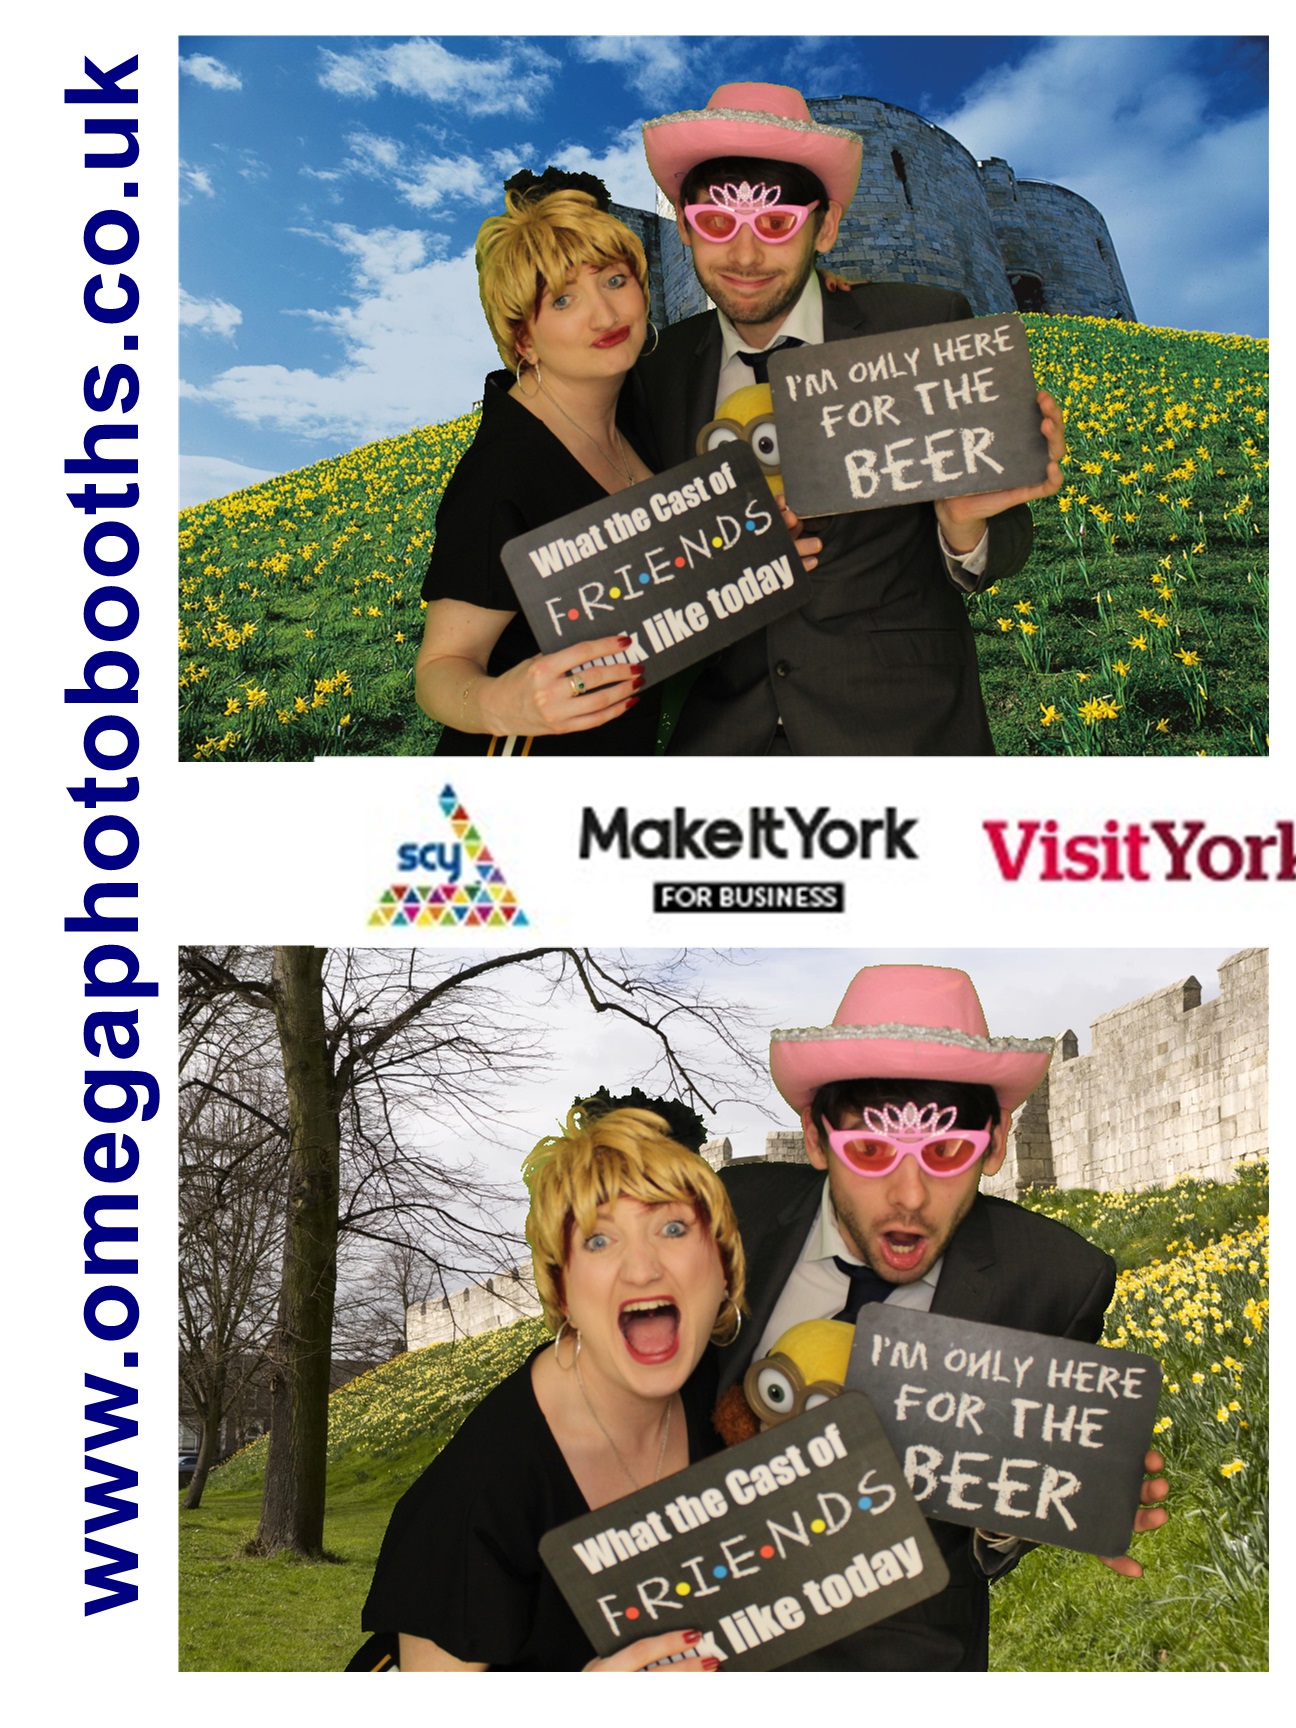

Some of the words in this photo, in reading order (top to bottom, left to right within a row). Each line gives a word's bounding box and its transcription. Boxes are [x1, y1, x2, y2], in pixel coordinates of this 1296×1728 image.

[785, 370, 837, 401] I'M
[848, 348, 920, 385] ONLY
[933, 325, 1015, 366] HERE
[820, 395, 900, 438] FOR
[914, 367, 1000, 416] THE
[844, 427, 1004, 499] BEER
[528, 527, 606, 578] What
[598, 504, 652, 544] the
[649, 477, 711, 523] Cast
[708, 462, 737, 498] of
[643, 595, 710, 655] like
[706, 555, 796, 622] today
[872, 1335, 928, 1371] I'M
[944, 1348, 1034, 1387] ONLY
[1047, 1359, 1147, 1400] HERE
[894, 1384, 986, 1436] FOR
[1011, 1398, 1109, 1449] THE
[573, 1514, 672, 1575] What
[662, 1488, 729, 1533] the
[725, 1446, 811, 1507] Cast
[807, 1423, 849, 1468] of
[904, 1444, 1082, 1532] BEER
[719, 1596, 807, 1655] like
[803, 1536, 924, 1615] today
